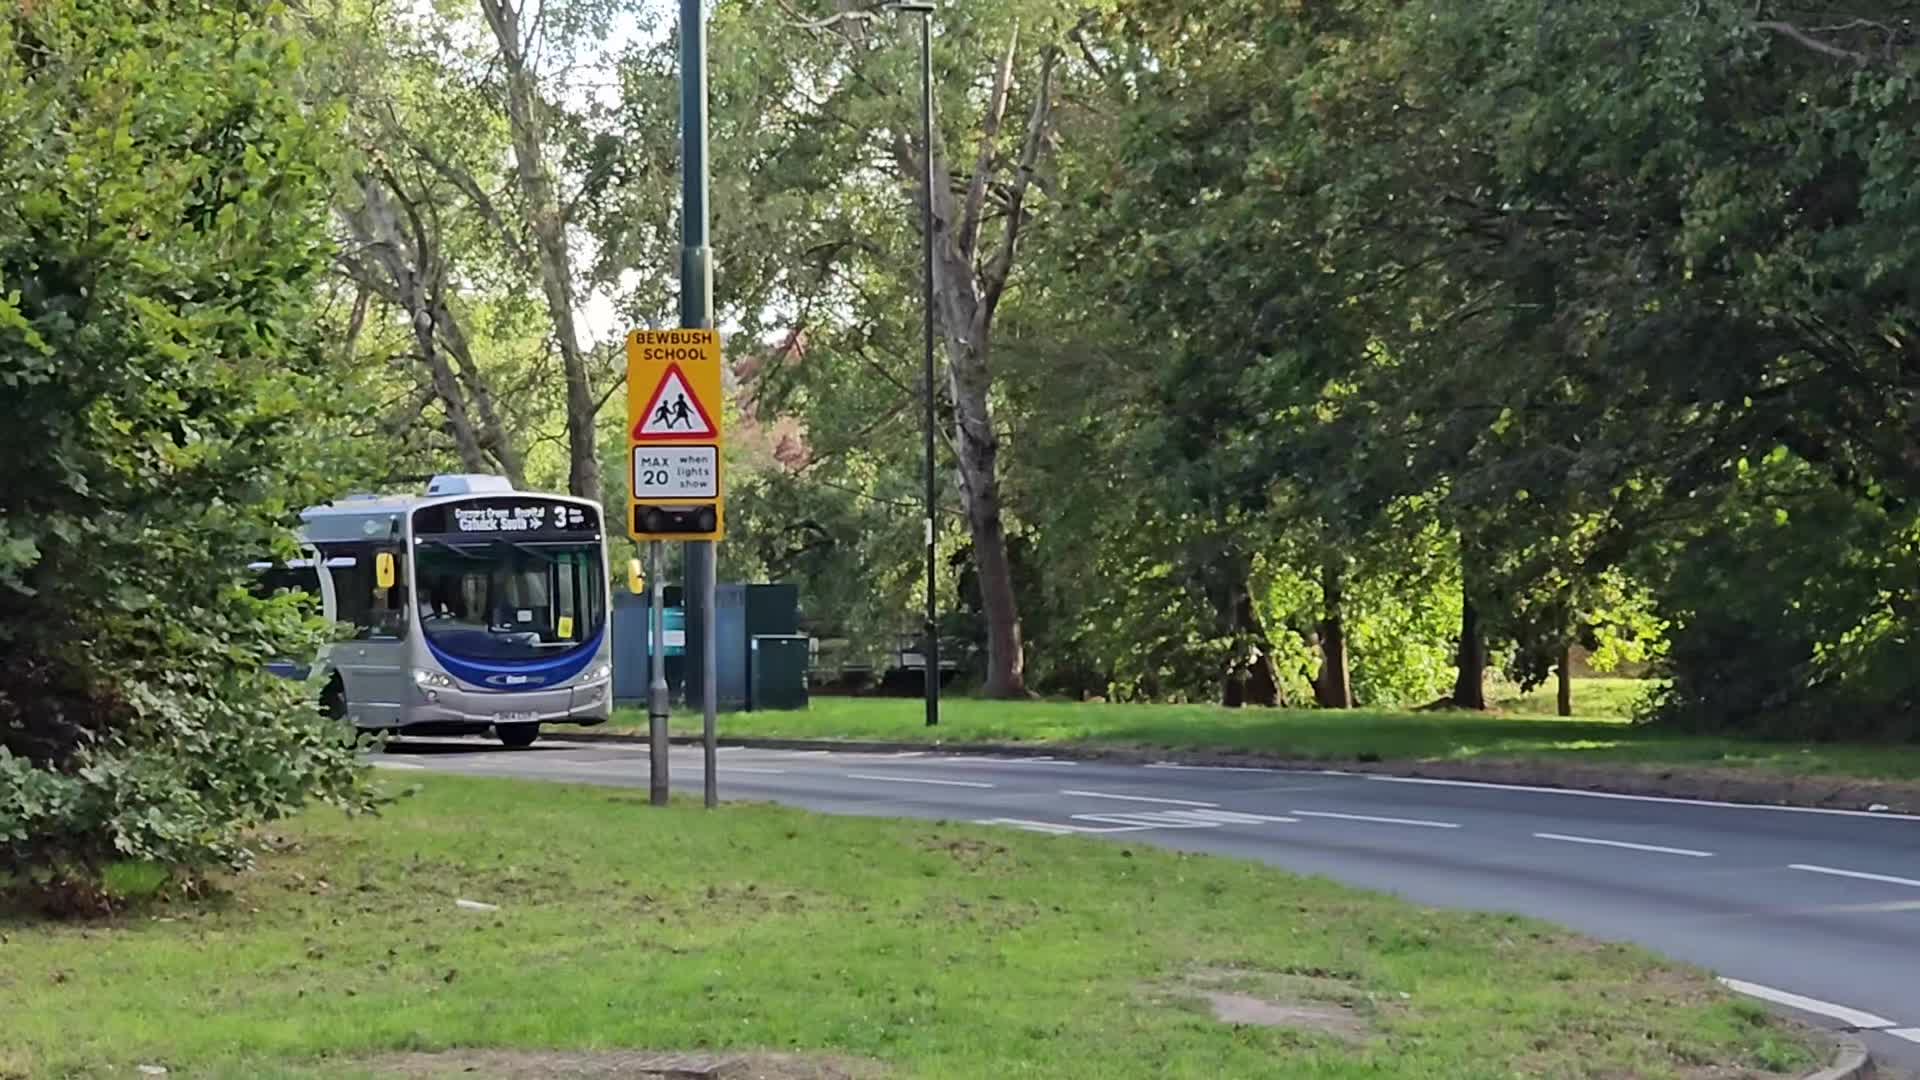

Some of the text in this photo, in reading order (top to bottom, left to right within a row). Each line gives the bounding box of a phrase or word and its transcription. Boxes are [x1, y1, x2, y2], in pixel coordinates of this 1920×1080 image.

[636, 332, 712, 344] BEWBUSH
[644, 348, 708, 360] SCHOOL
[641, 457, 669, 467] MAX
[679, 456, 708, 464] when
[643, 470, 669, 485] 20
[677, 467, 709, 477] lights
[680, 480, 707, 488] show
[554, 506, 567, 528] 3
